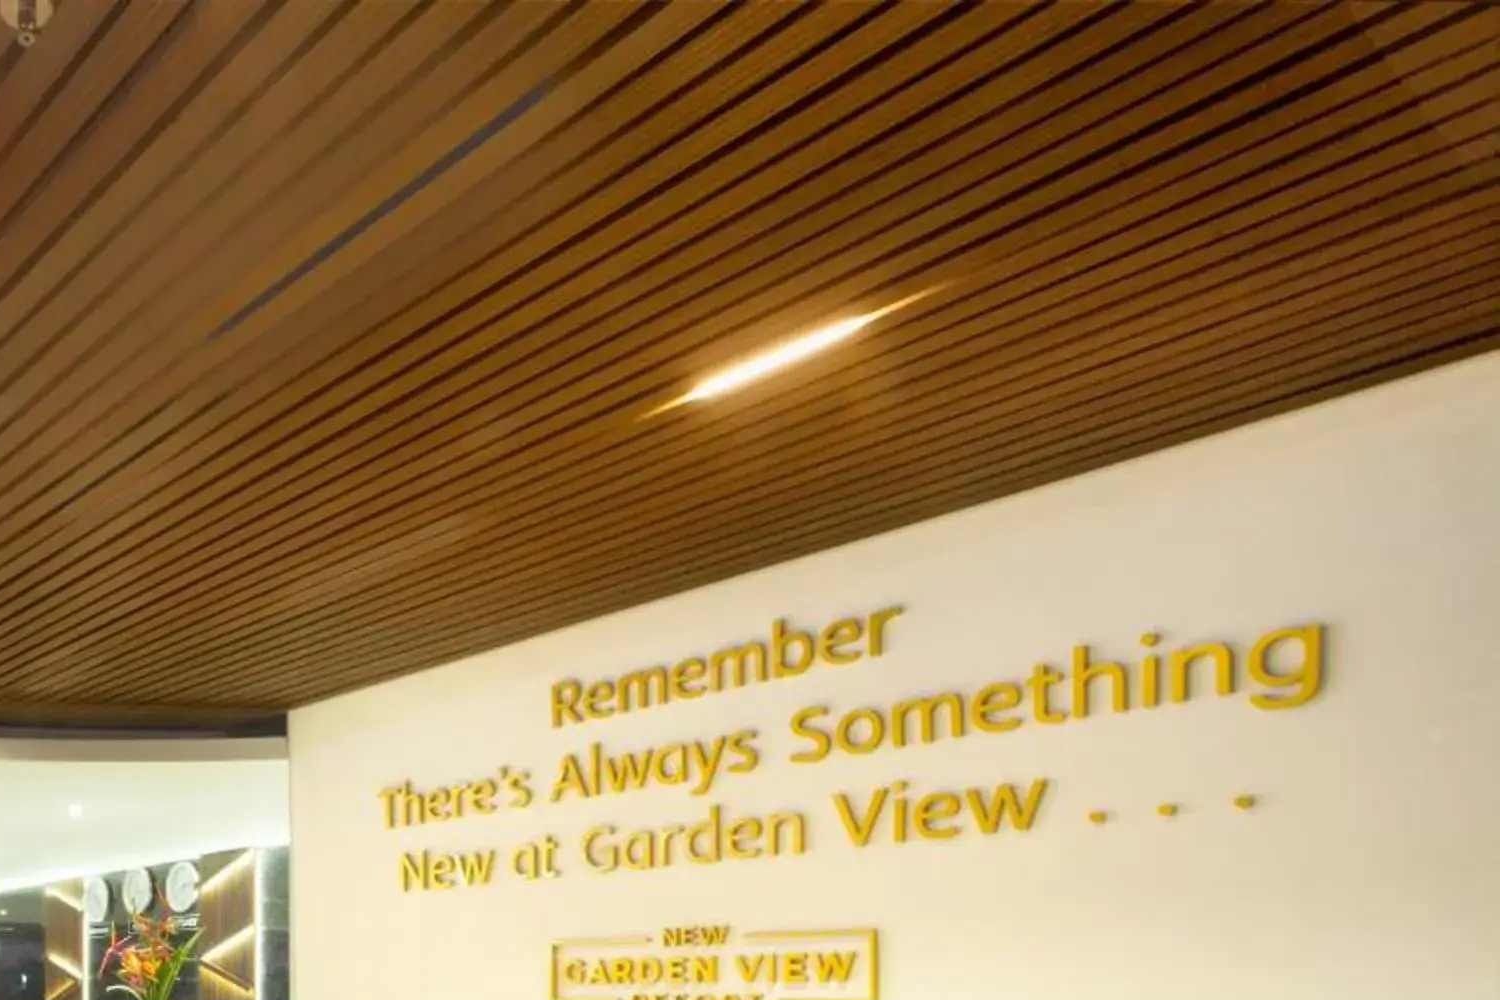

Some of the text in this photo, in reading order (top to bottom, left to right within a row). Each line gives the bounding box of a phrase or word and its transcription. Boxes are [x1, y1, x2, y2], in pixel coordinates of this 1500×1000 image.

[378, 622, 1329, 829] There's Always Something
[550, 606, 903, 729] Remember
[399, 849, 497, 893] New
[511, 833, 560, 881] at
[581, 804, 807, 874] Garden
[832, 776, 1049, 847] View
[565, 952, 858, 985] GARDEN VIEW
[662, 925, 731, 947] NEW
